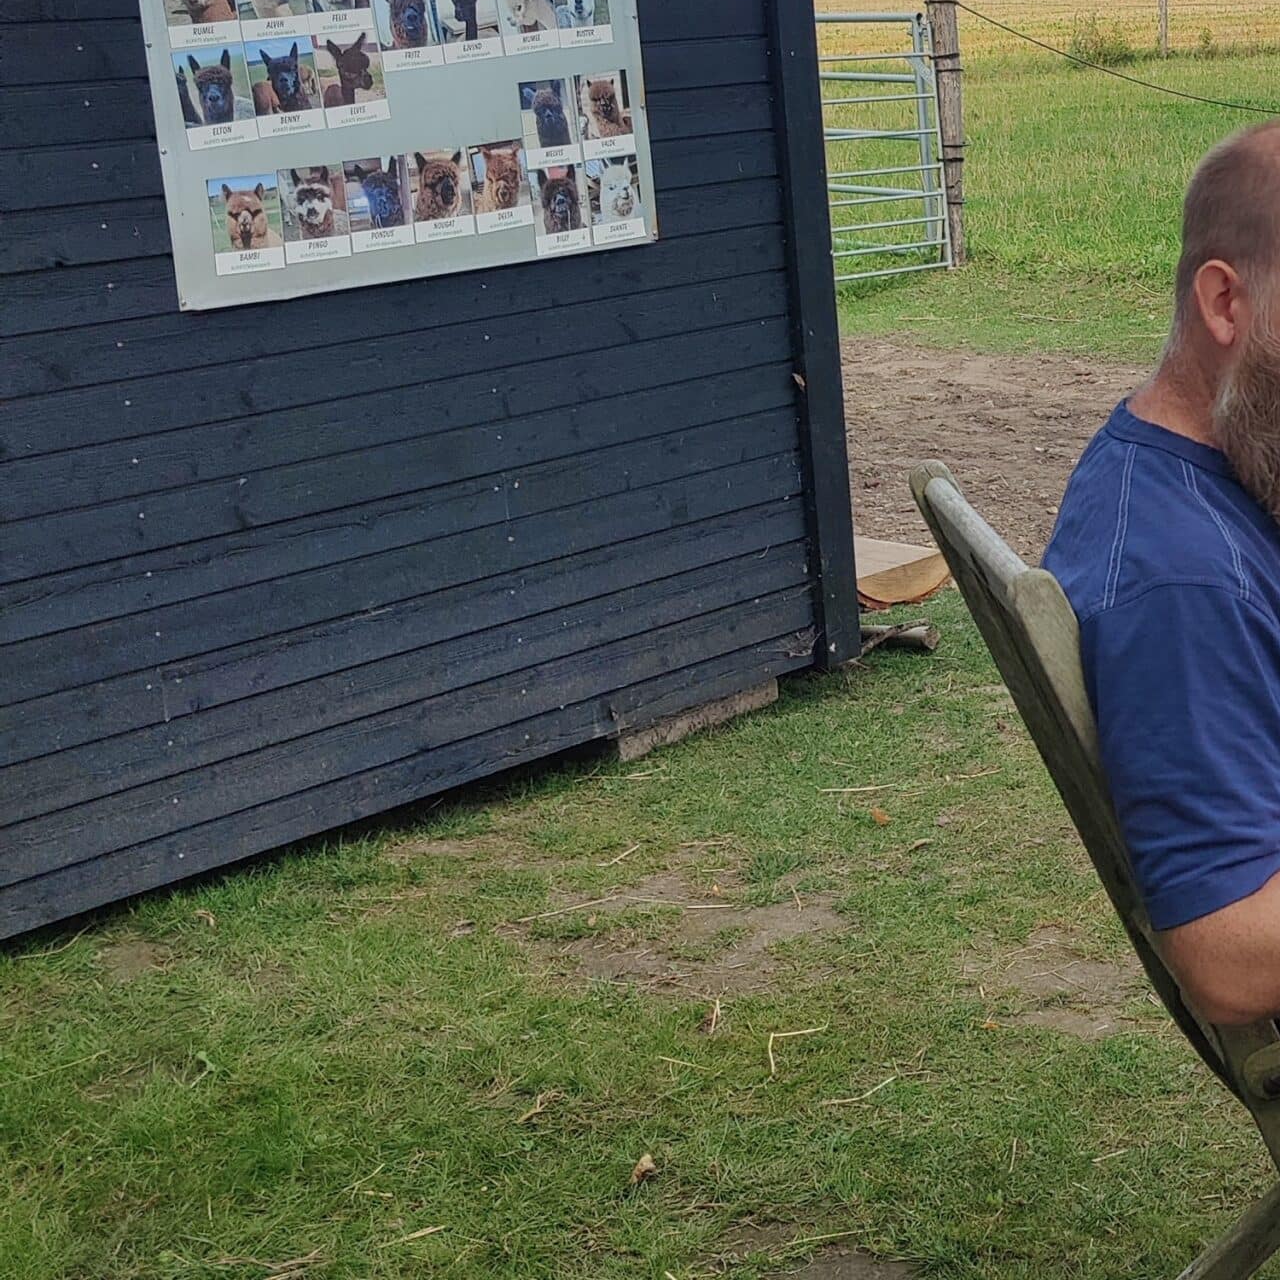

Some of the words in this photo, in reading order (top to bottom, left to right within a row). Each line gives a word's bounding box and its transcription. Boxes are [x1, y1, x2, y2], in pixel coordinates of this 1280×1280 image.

[332, 13, 348, 22] FELIX
[266, 21, 284, 29] ALVIN
[405, 50, 420, 59] FRITZ
[280, 114, 301, 124] BENNY
[212, 126, 232, 136] ELTON
[497, 210, 513, 221] DELTA
[240, 252, 260, 262] BAMBI
